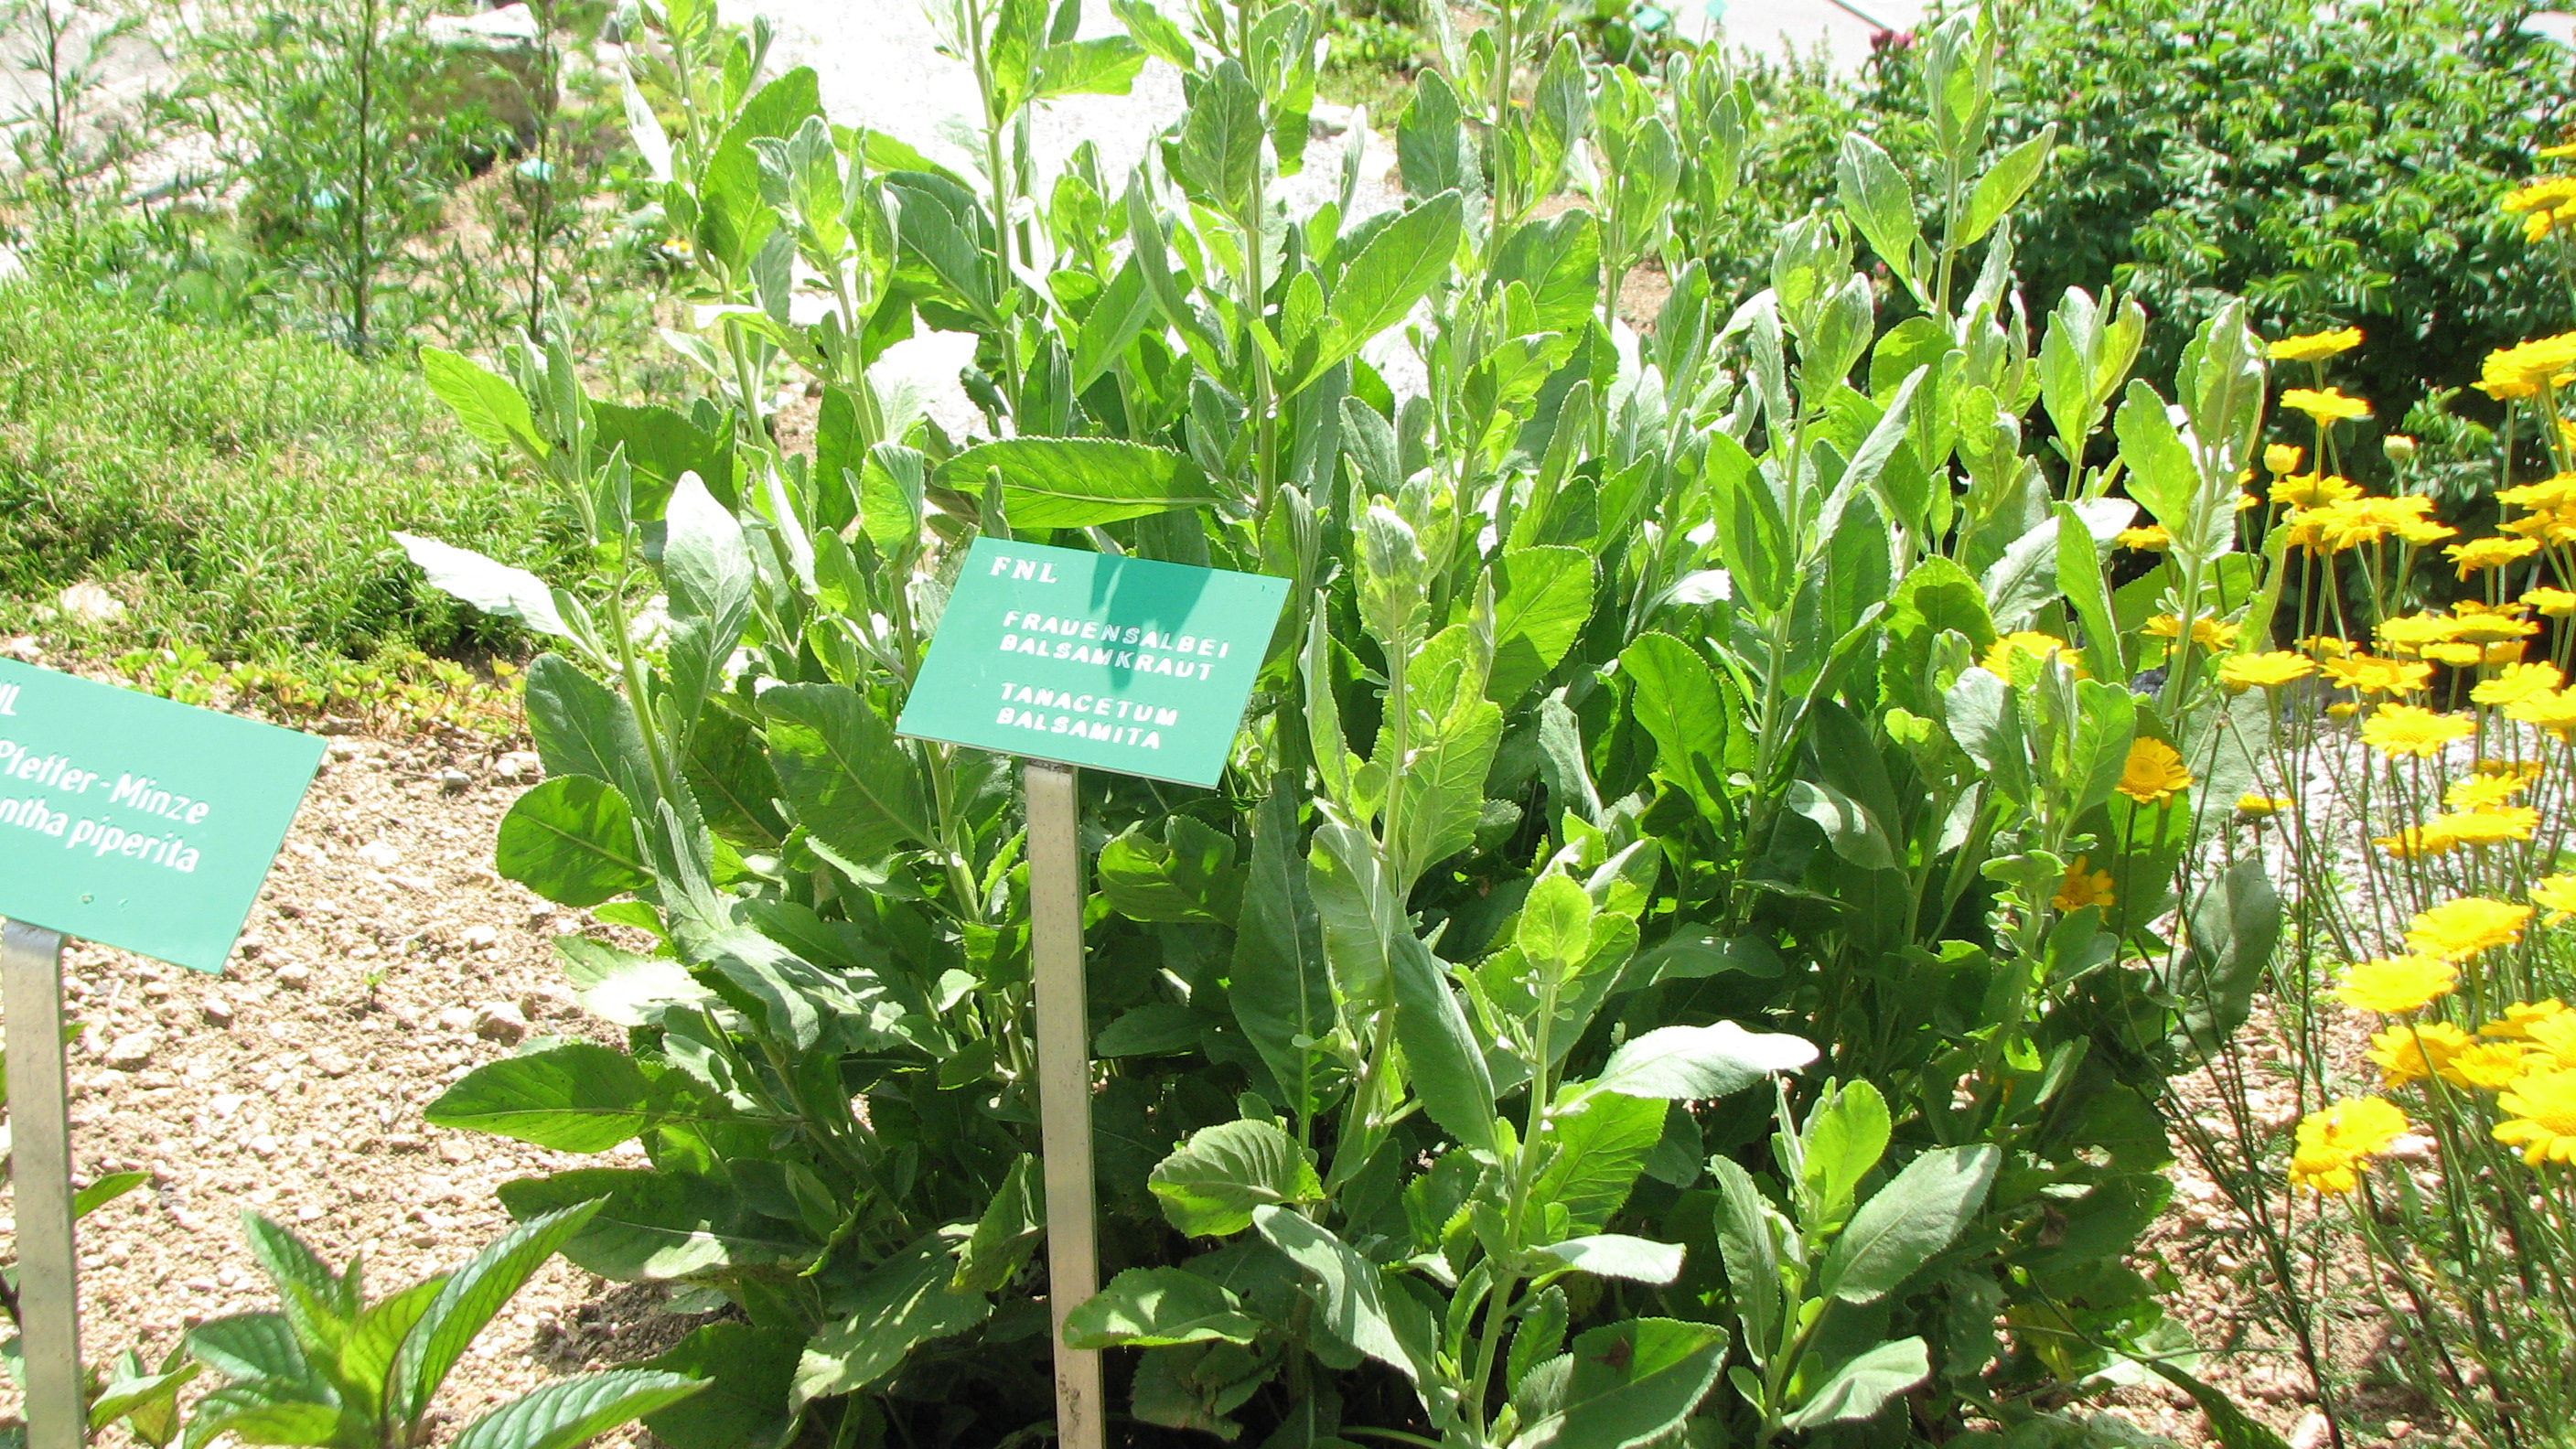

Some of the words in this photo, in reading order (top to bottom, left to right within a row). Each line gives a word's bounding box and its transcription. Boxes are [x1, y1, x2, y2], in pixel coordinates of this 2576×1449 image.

[990, 556, 1057, 584] FNL
[1003, 610, 1229, 659] FRAUENSALBEI
[999, 635, 1216, 681] BALSAMKRAUT
[1000, 683, 1178, 726] TANACETUM
[995, 708, 1161, 749] BALSAMITA
[66, 816, 199, 873] piperita
